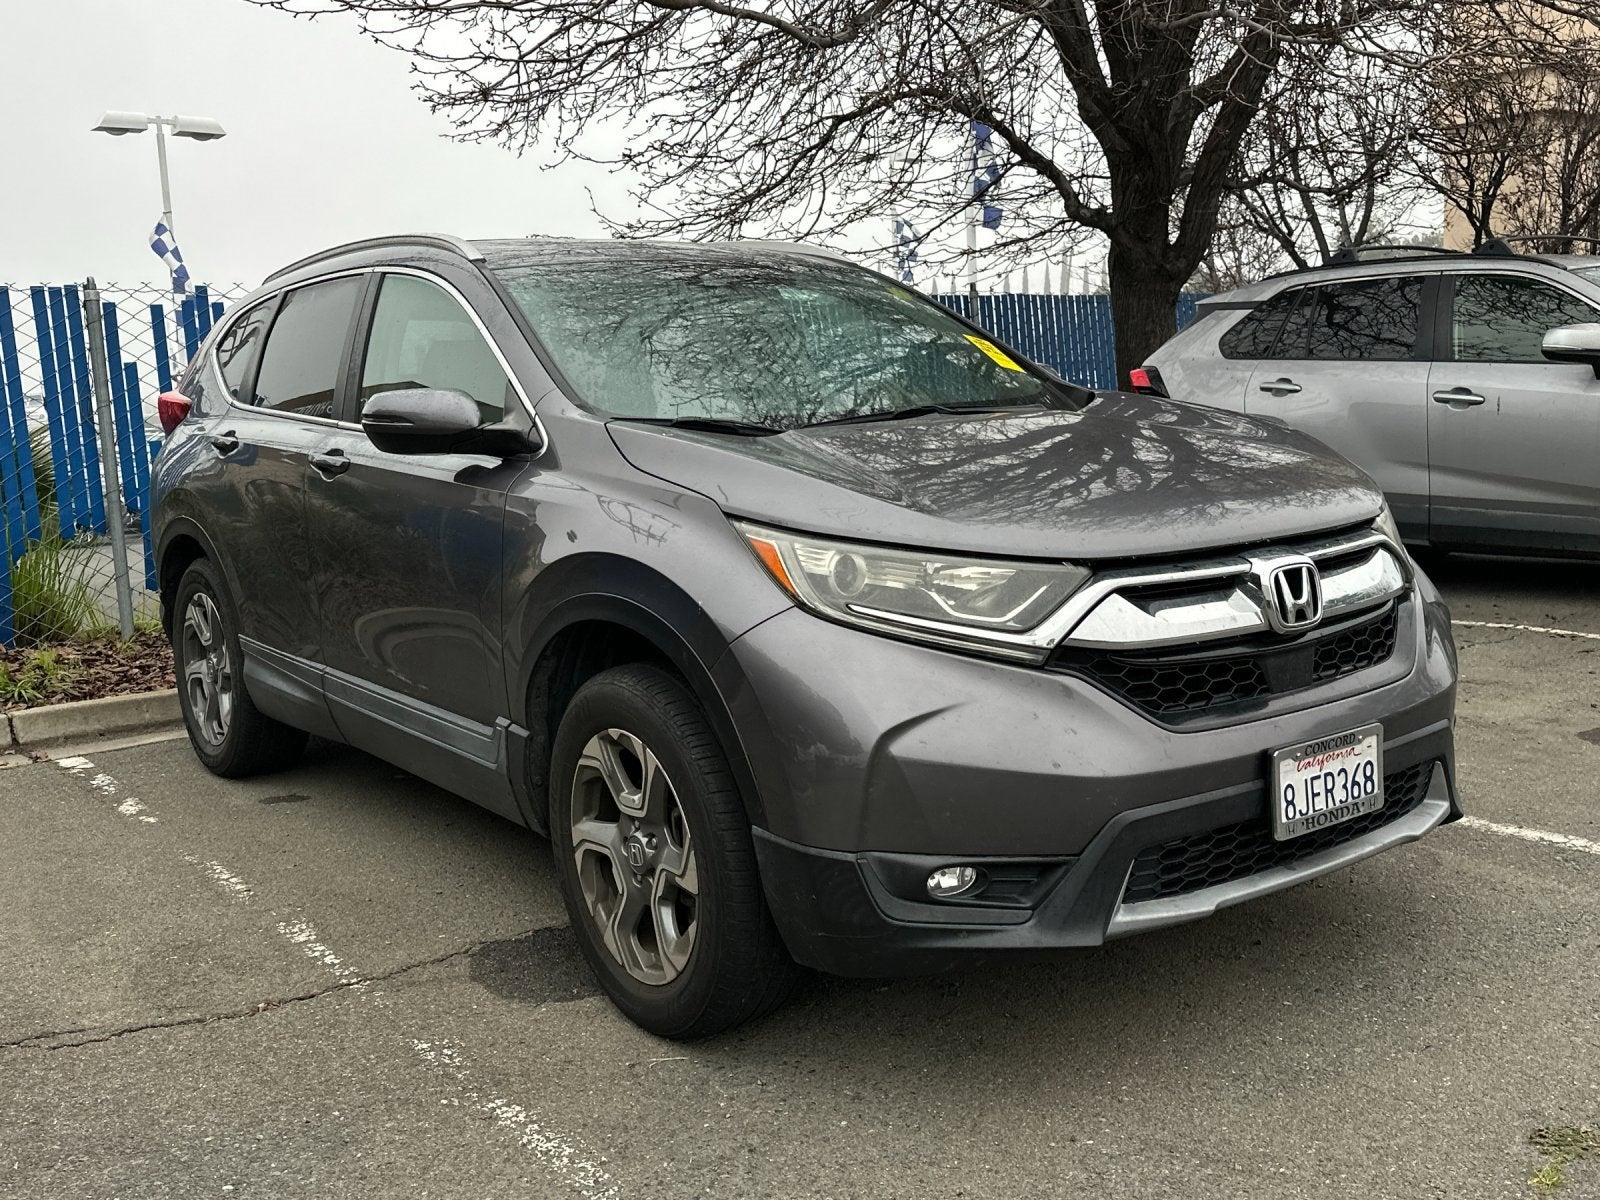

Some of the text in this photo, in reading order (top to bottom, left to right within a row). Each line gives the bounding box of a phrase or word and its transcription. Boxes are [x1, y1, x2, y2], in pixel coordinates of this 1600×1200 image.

[1305, 734, 1356, 757] CONCORD
[1296, 746, 1362, 772] California
[1284, 760, 1376, 821] 8JER368
